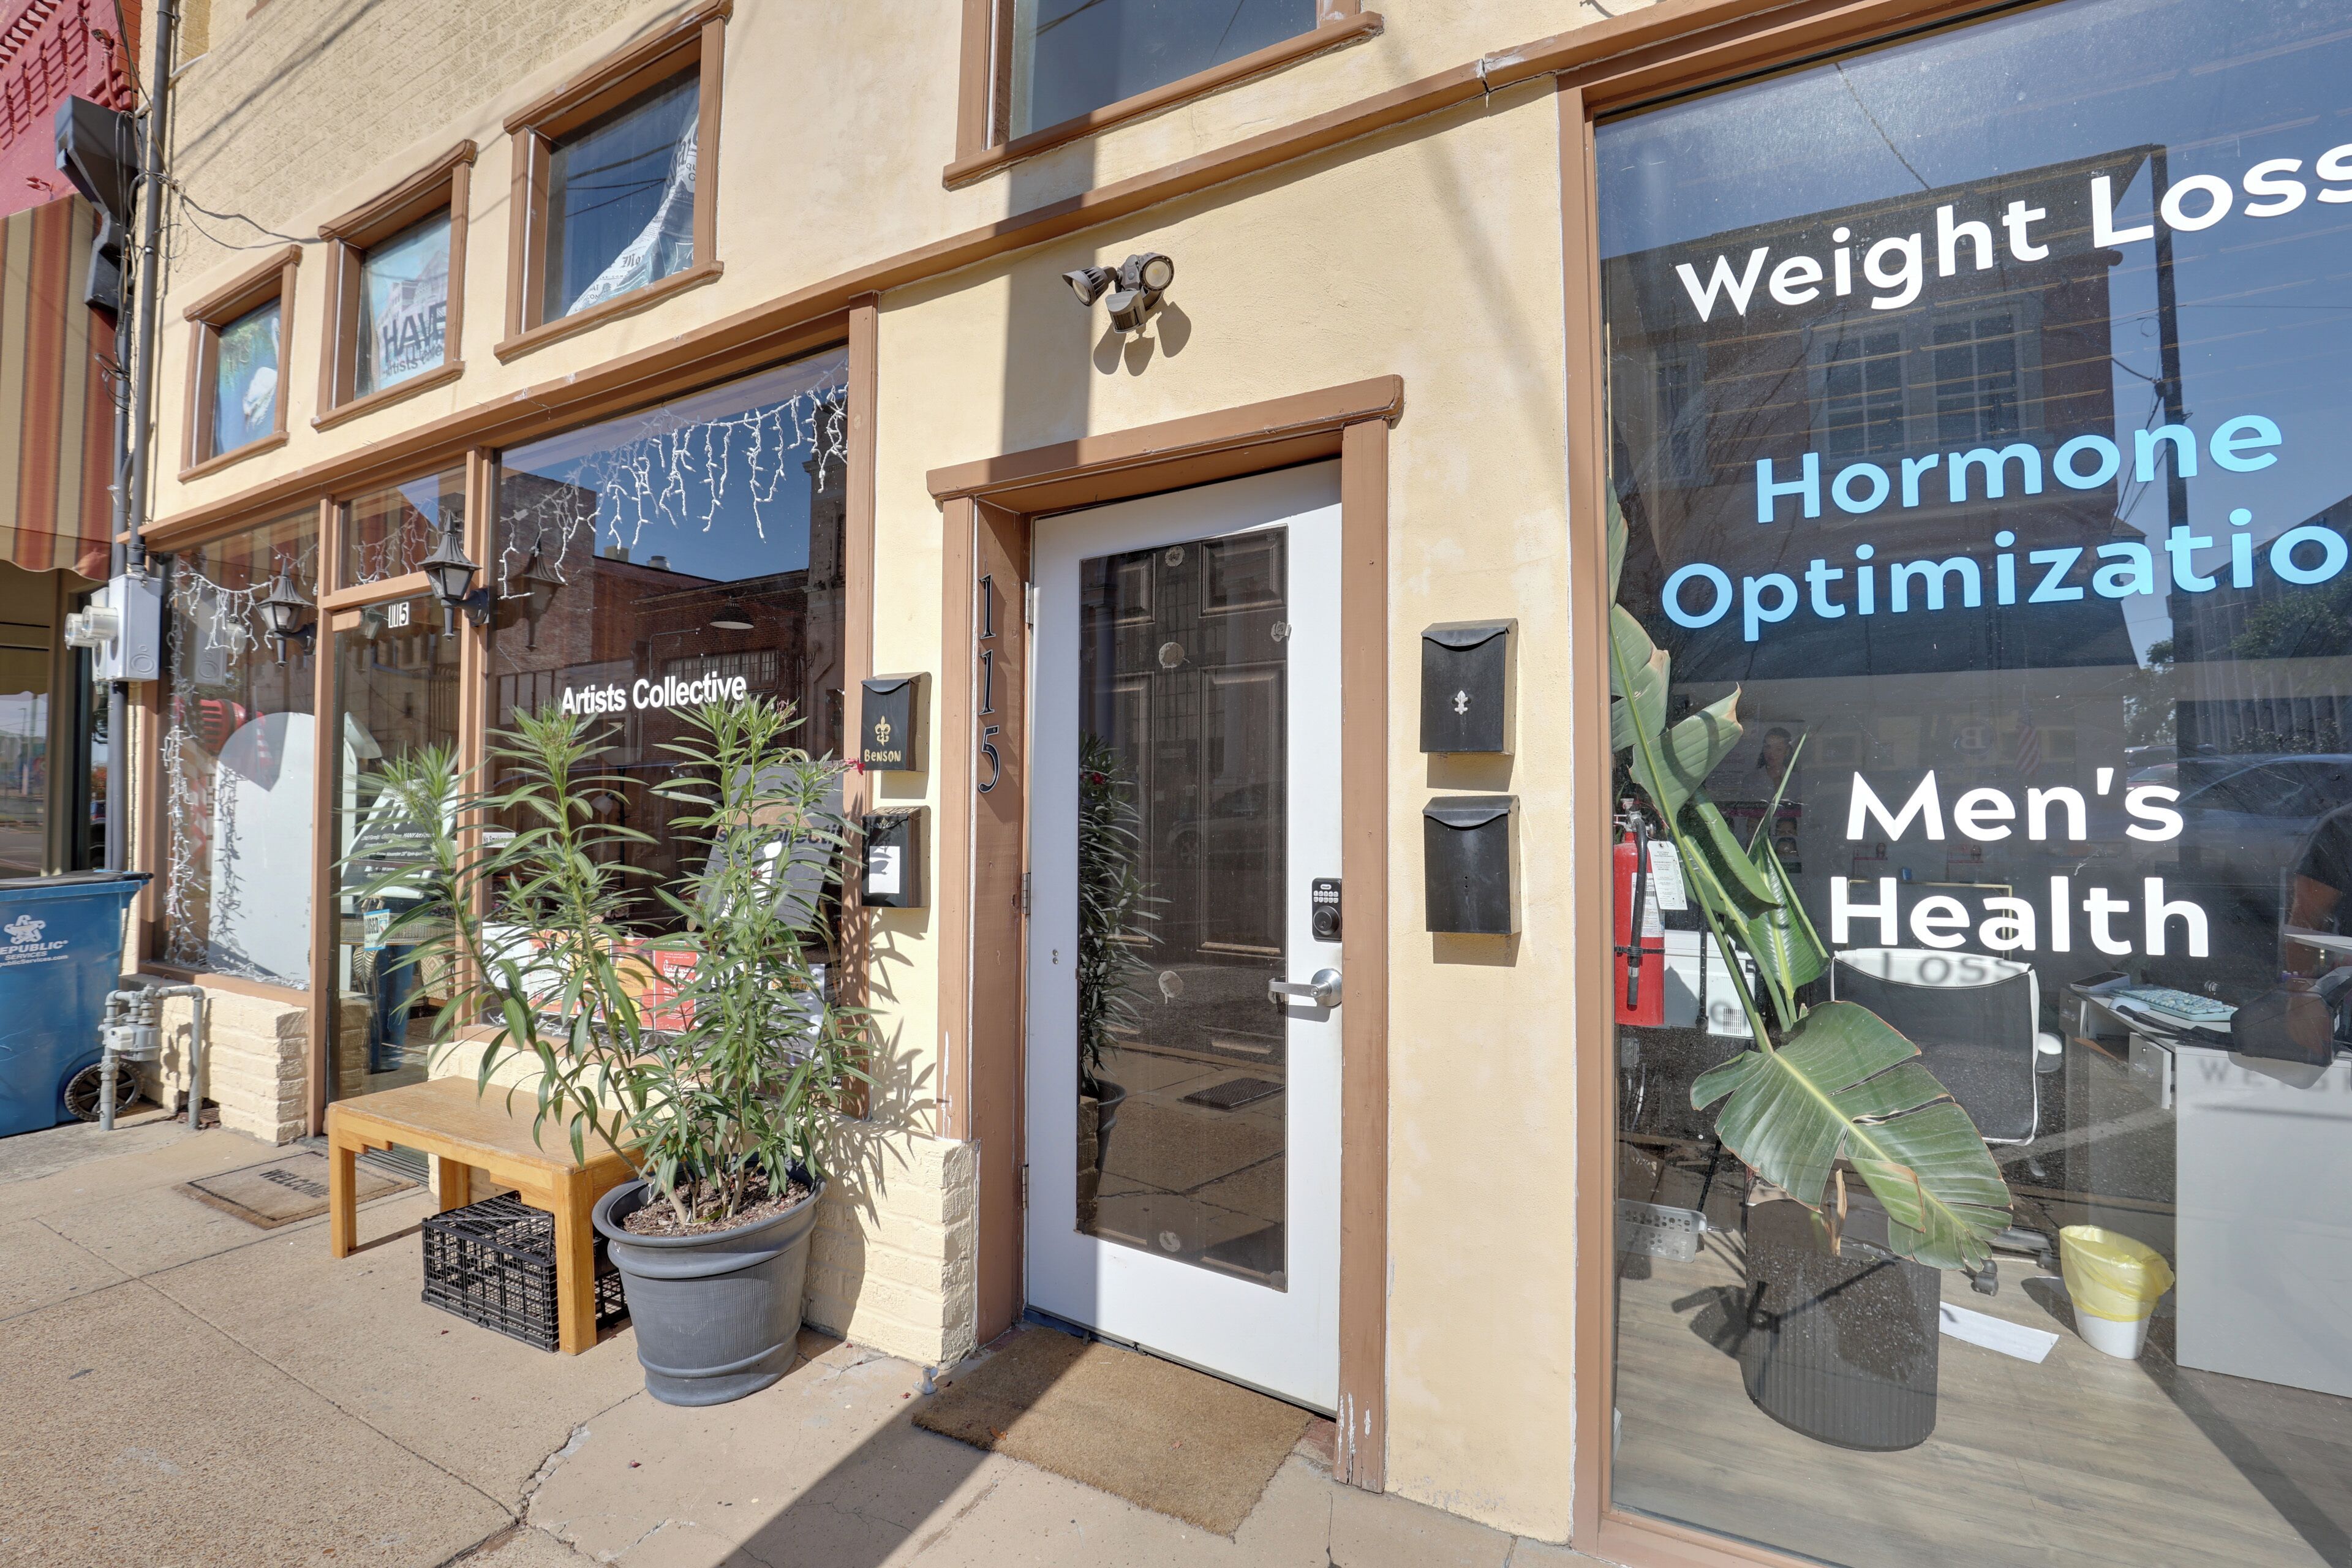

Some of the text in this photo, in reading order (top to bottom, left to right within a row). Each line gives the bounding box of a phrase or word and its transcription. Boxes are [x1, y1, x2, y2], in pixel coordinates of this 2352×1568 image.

[1676, 201, 2048, 322] Weight
[1757, 415, 2282, 522] Hormone
[1662, 508, 2348, 641] Optimizatio
[389, 603, 408, 627] 115
[561, 671, 746, 715] Artists Collective
[978, 573, 1000, 794] 115
[1847, 768, 2184, 842] Men's
[1831, 876, 2209, 957] Health
[5, 951, 48, 960] SERVICES
[259, 1168, 330, 1198] WELCOME
